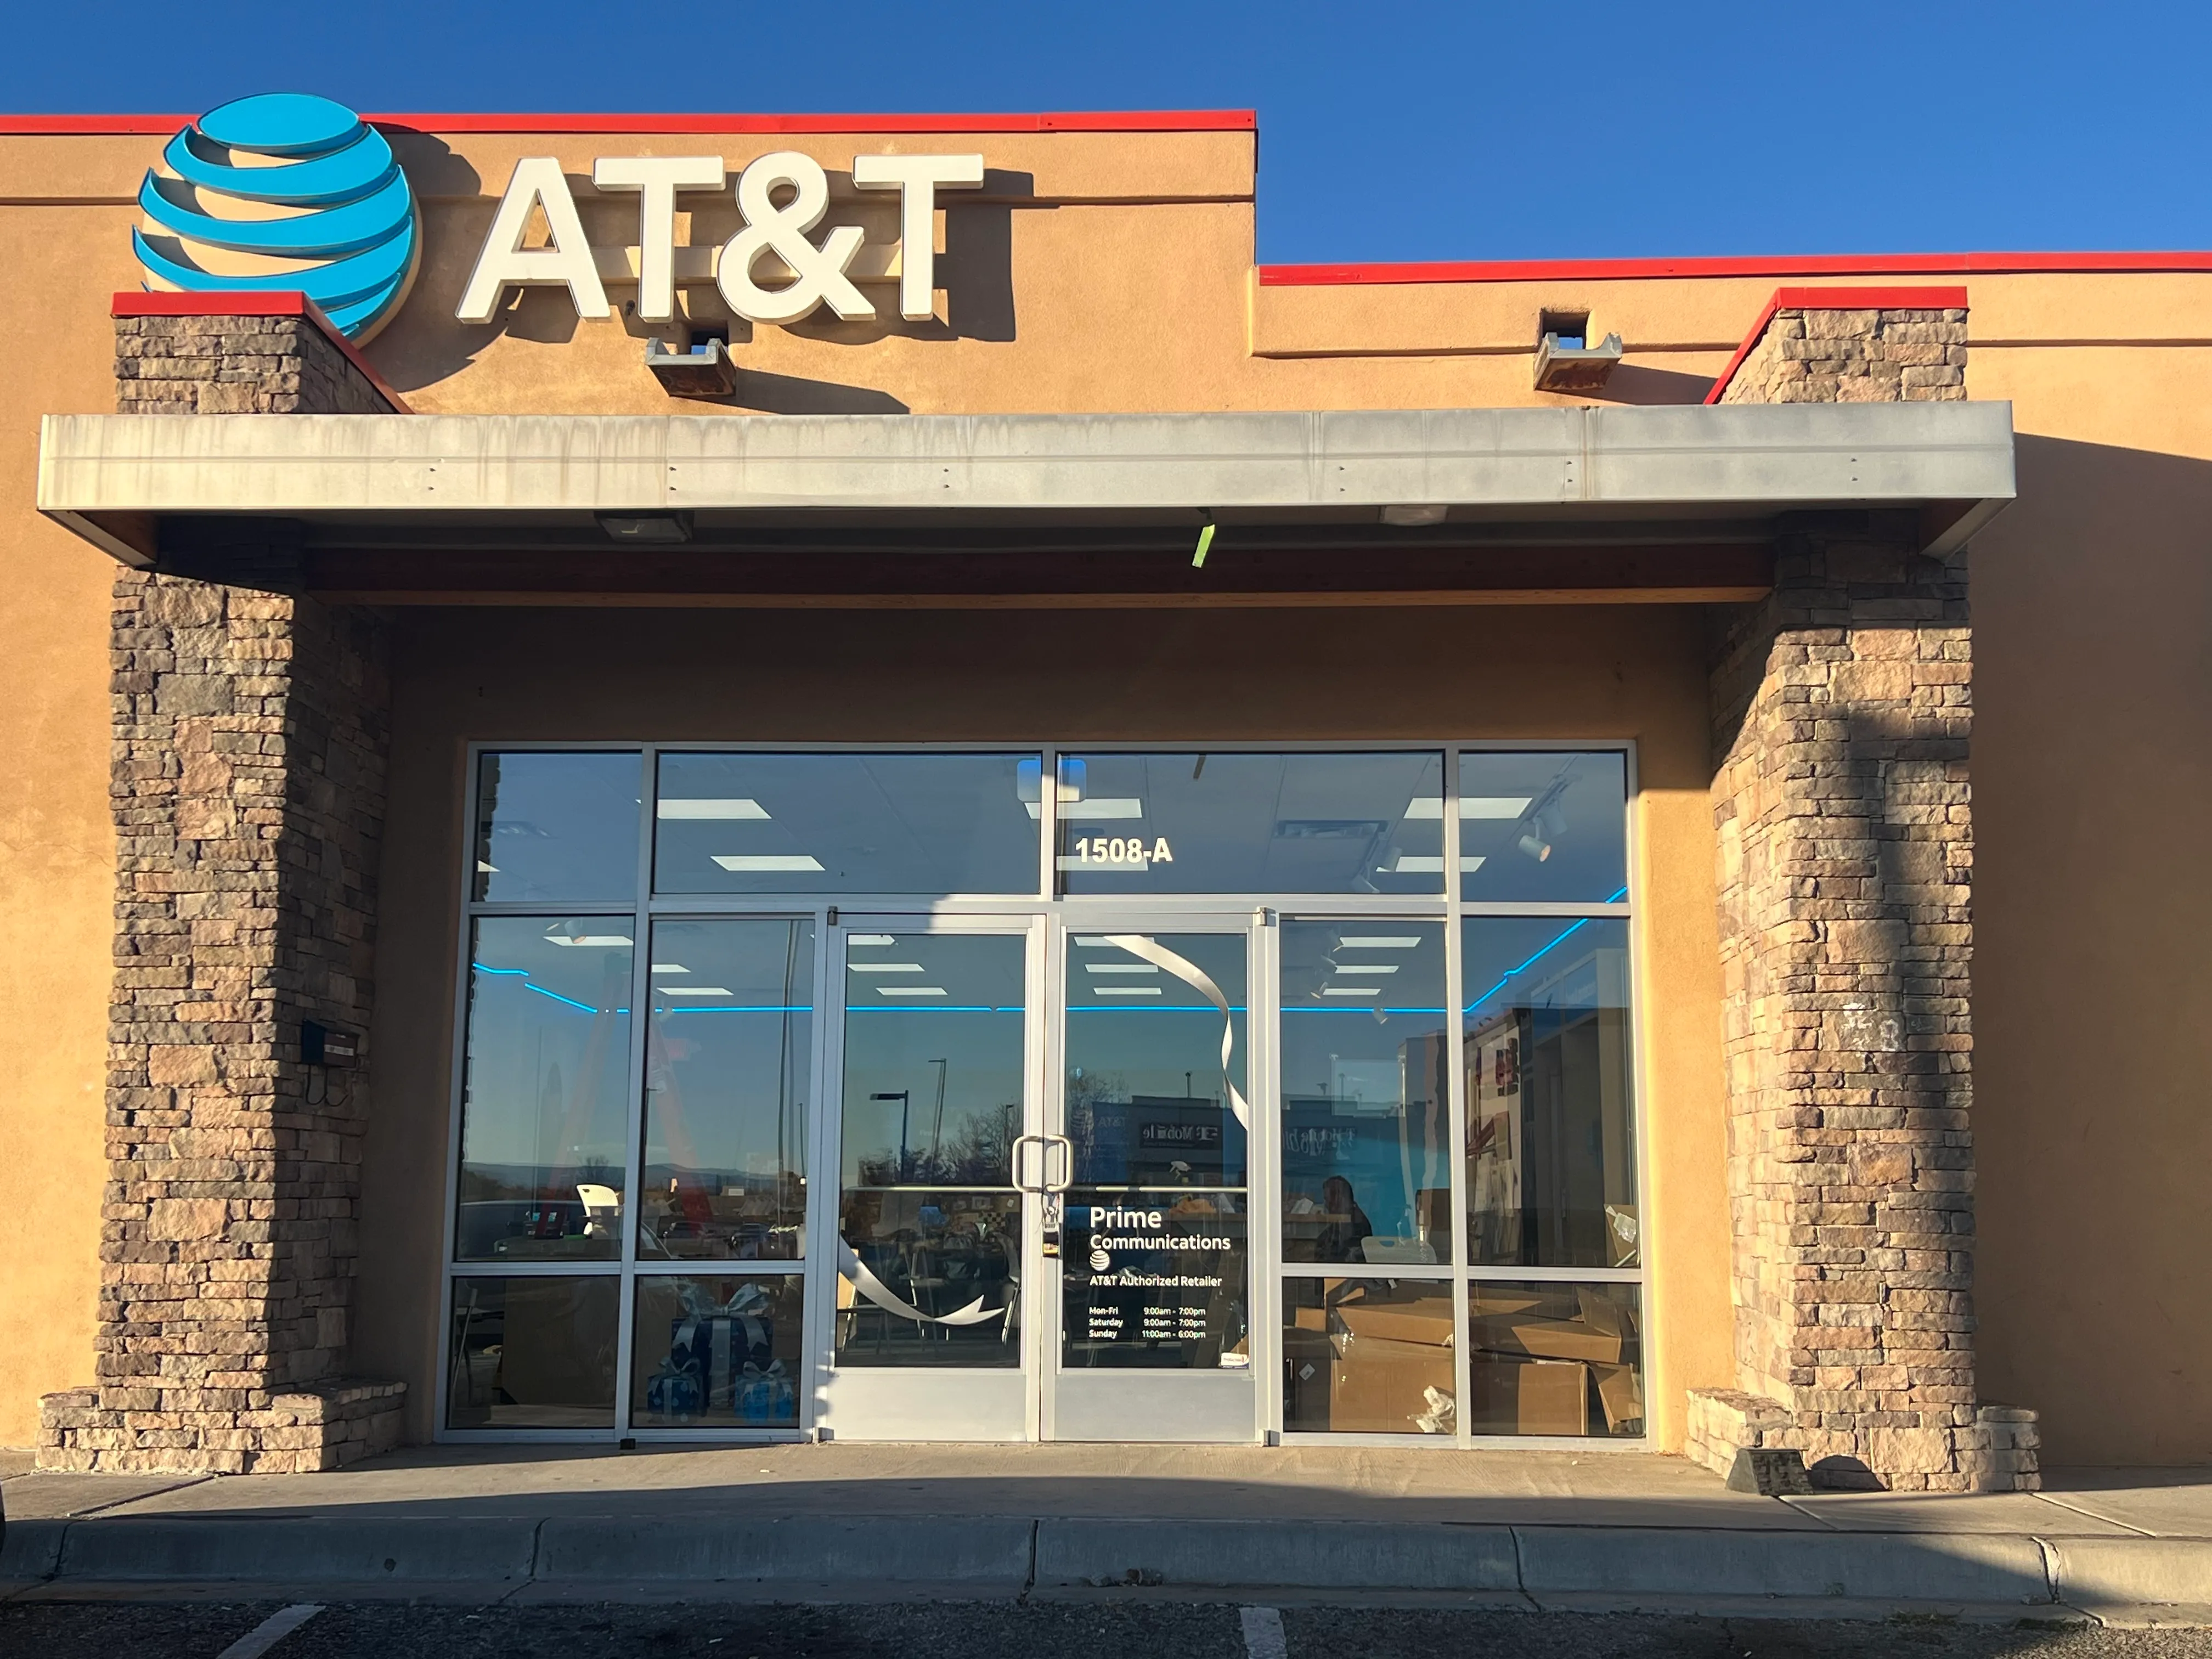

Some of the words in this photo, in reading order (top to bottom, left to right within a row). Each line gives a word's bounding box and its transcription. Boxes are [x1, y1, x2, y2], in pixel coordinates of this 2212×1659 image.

[455, 151, 984, 325] AT&T
[1075, 837, 1173, 863] 1508-A
[1090, 1205, 1162, 1228] Prime
[1090, 1233, 1231, 1250] Communications
[1090, 1275, 1118, 1286] AT&T
[1119, 1274, 1178, 1286] Authorized
[1181, 1275, 1223, 1286] Retailer
[1088, 1306, 1119, 1316] Mon-Fri
[1143, 1307, 1171, 1316] 9:00am
[1178, 1307, 1206, 1317] 7:00pm
[1088, 1317, 1124, 1328] Saturday
[1143, 1318, 1171, 1327] 9:00am
[1178, 1318, 1206, 1328] 7:00pm
[1088, 1329, 1118, 1340] Sunday
[1142, 1330, 1171, 1338] 11:00am
[1178, 1330, 1206, 1340] 6:00pm
